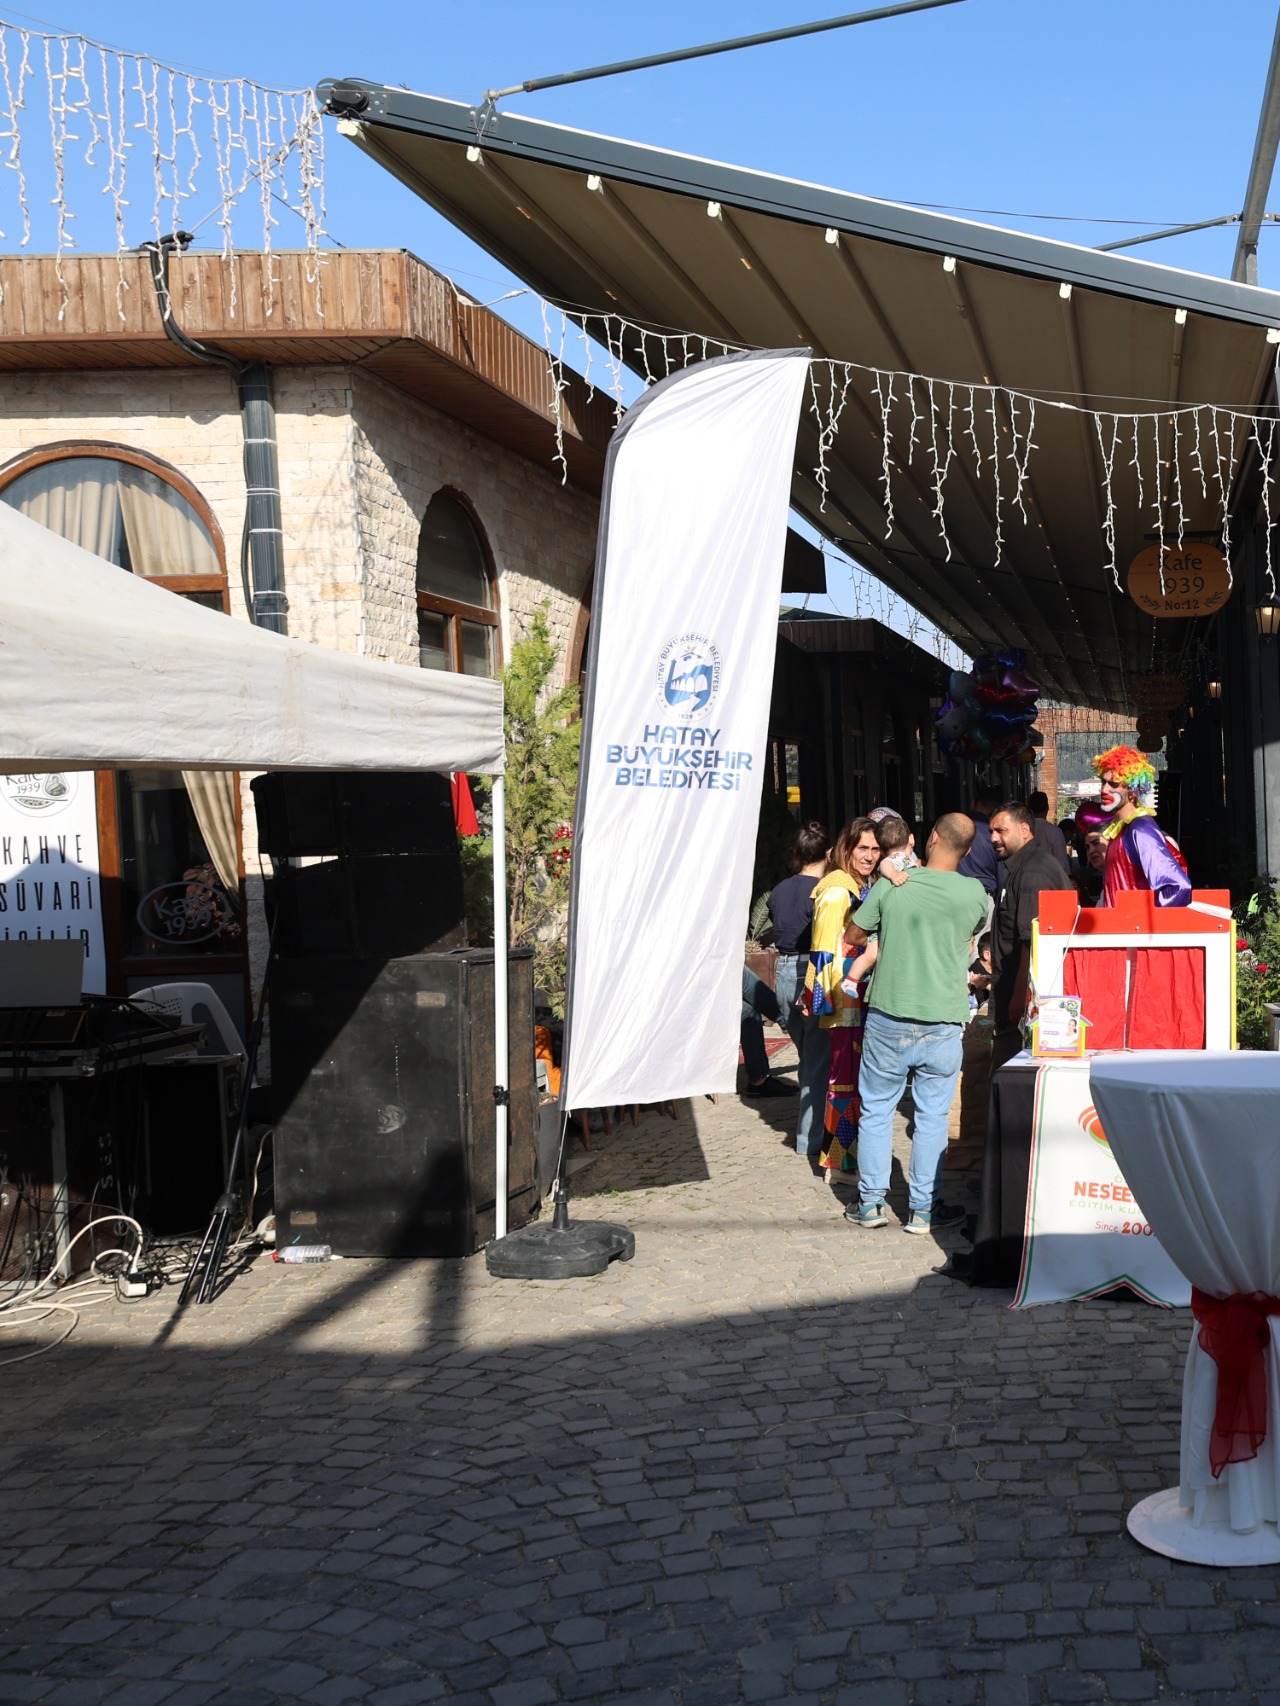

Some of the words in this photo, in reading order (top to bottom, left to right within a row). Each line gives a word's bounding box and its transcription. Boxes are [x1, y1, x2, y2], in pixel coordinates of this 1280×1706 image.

[1158, 553, 1203, 571] Kafe
[1165, 600, 1200, 610] No:12
[643, 725, 721, 746] HATAY
[606, 745, 753, 771] BÜYÜKŞEHİR
[17, 782, 41, 794] 1939
[615, 767, 741, 791] BELEDİYESİ
[3, 834, 83, 865] KAHVE
[0, 877, 93, 912] SÜVARİ
[1074, 1181, 1138, 1203] NEŞ'EE
[1095, 1221, 1118, 1232] Since
[1121, 1221, 1156, 1237] 200
